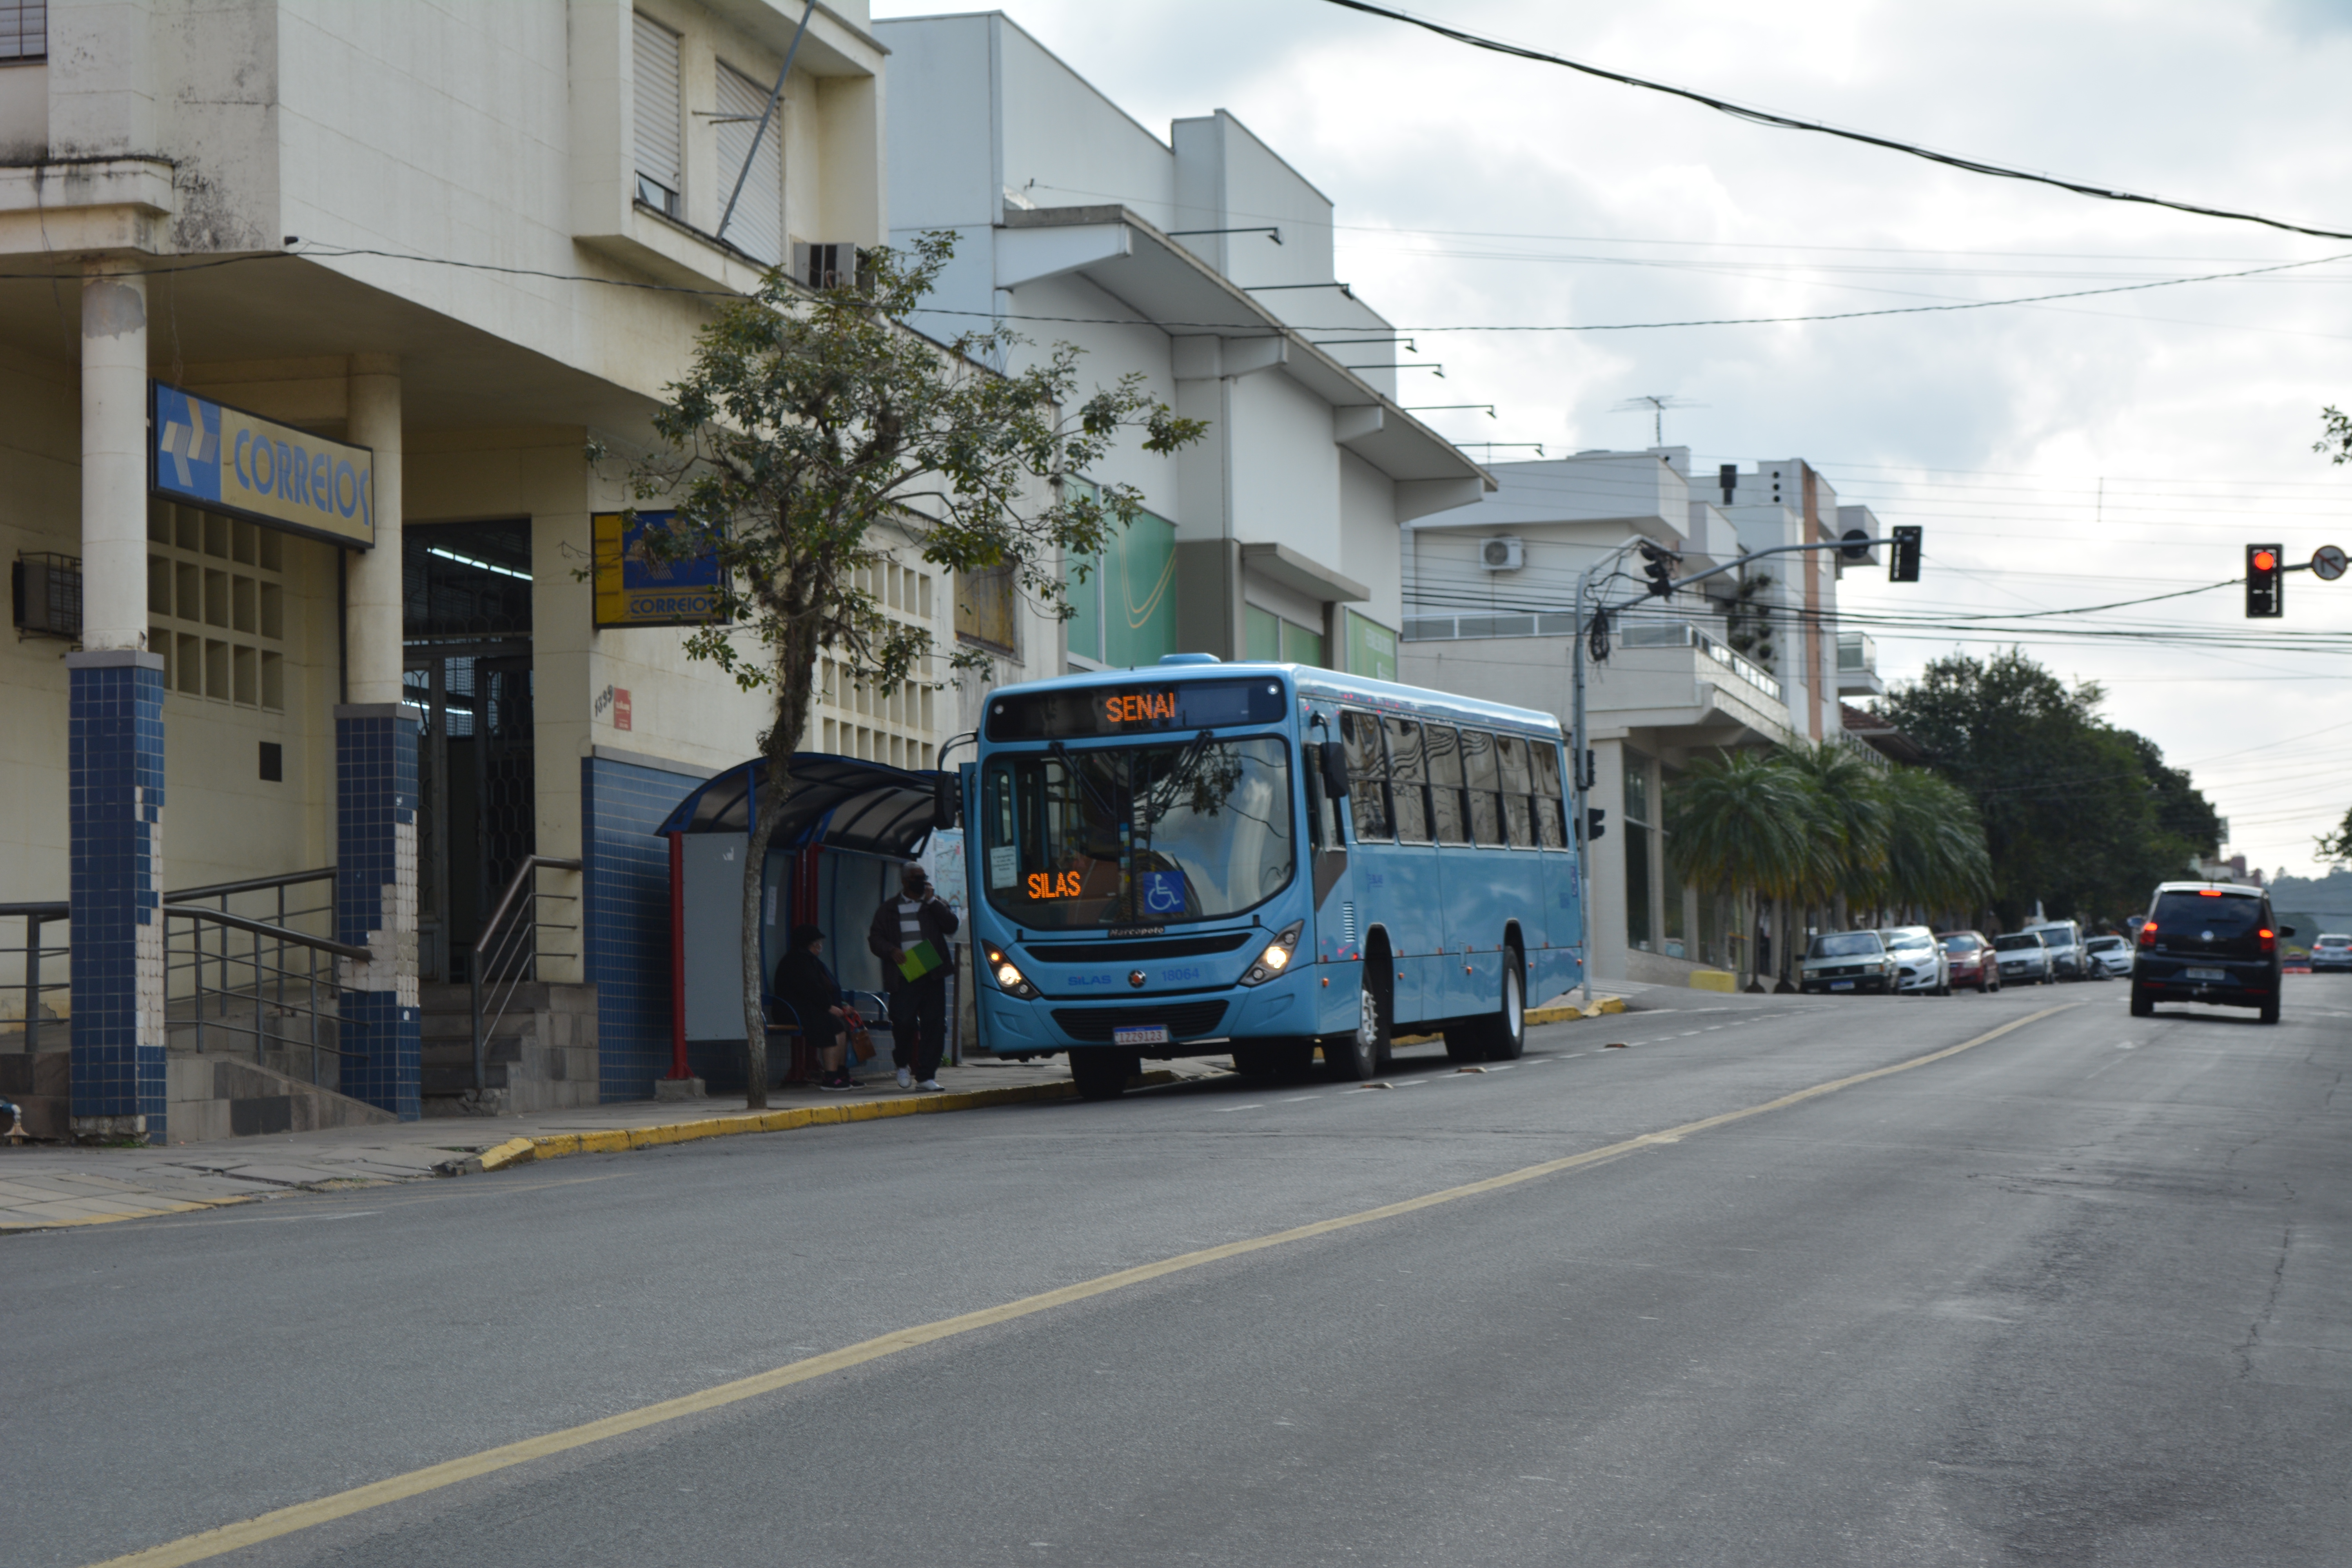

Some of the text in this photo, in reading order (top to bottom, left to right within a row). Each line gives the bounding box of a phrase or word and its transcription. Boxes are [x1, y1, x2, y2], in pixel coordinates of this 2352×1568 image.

[234, 428, 369, 526] CORREIOS
[1106, 692, 1175, 722] SENAI
[1028, 871, 1081, 898] SILAS
[1161, 968, 1200, 981] 18064
